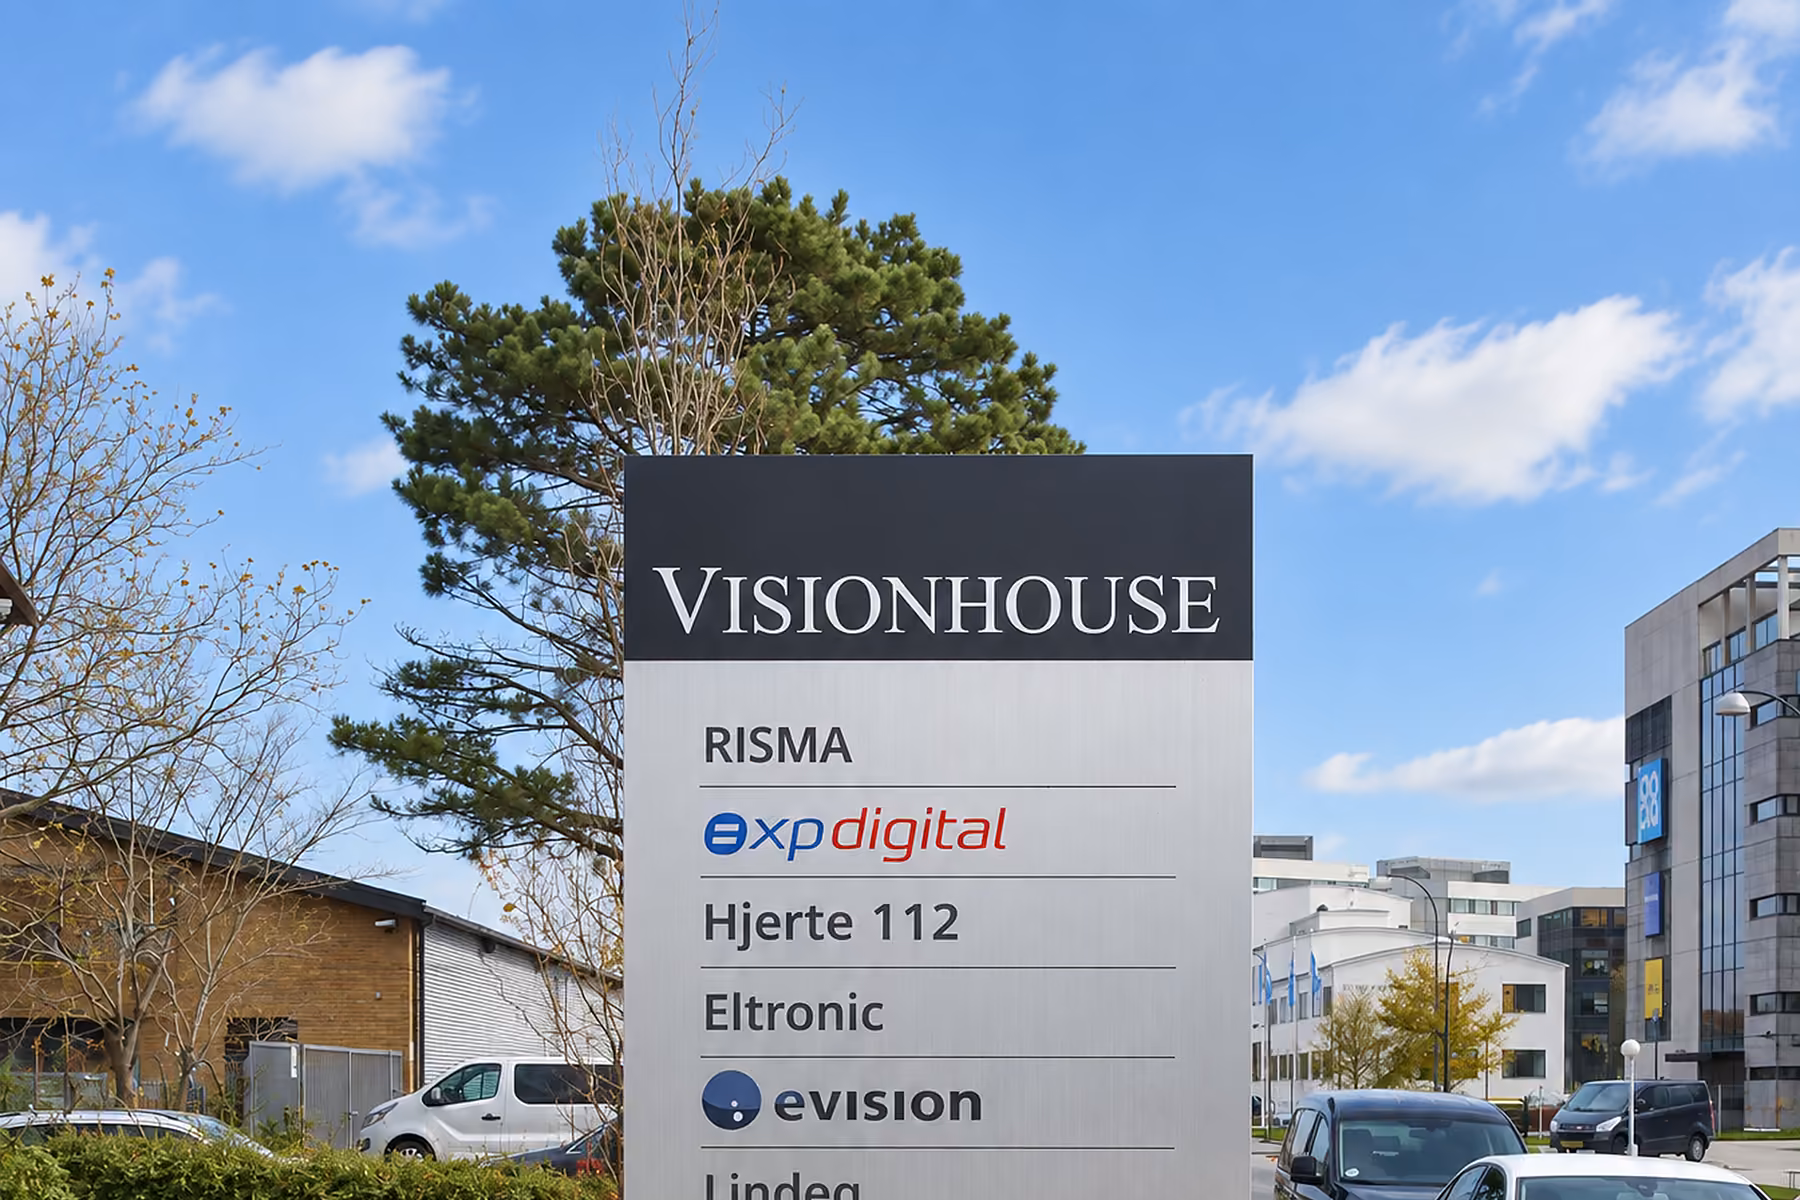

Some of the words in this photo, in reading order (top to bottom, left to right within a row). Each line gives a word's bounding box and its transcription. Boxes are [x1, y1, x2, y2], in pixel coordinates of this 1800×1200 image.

[652, 567, 1220, 636] VISIONHOUSE
[704, 726, 853, 764] RISMA
[704, 901, 854, 952] Hjerte
[873, 903, 959, 941] 112
[704, 991, 884, 1032] Eltronic
[774, 1090, 982, 1122] evision
